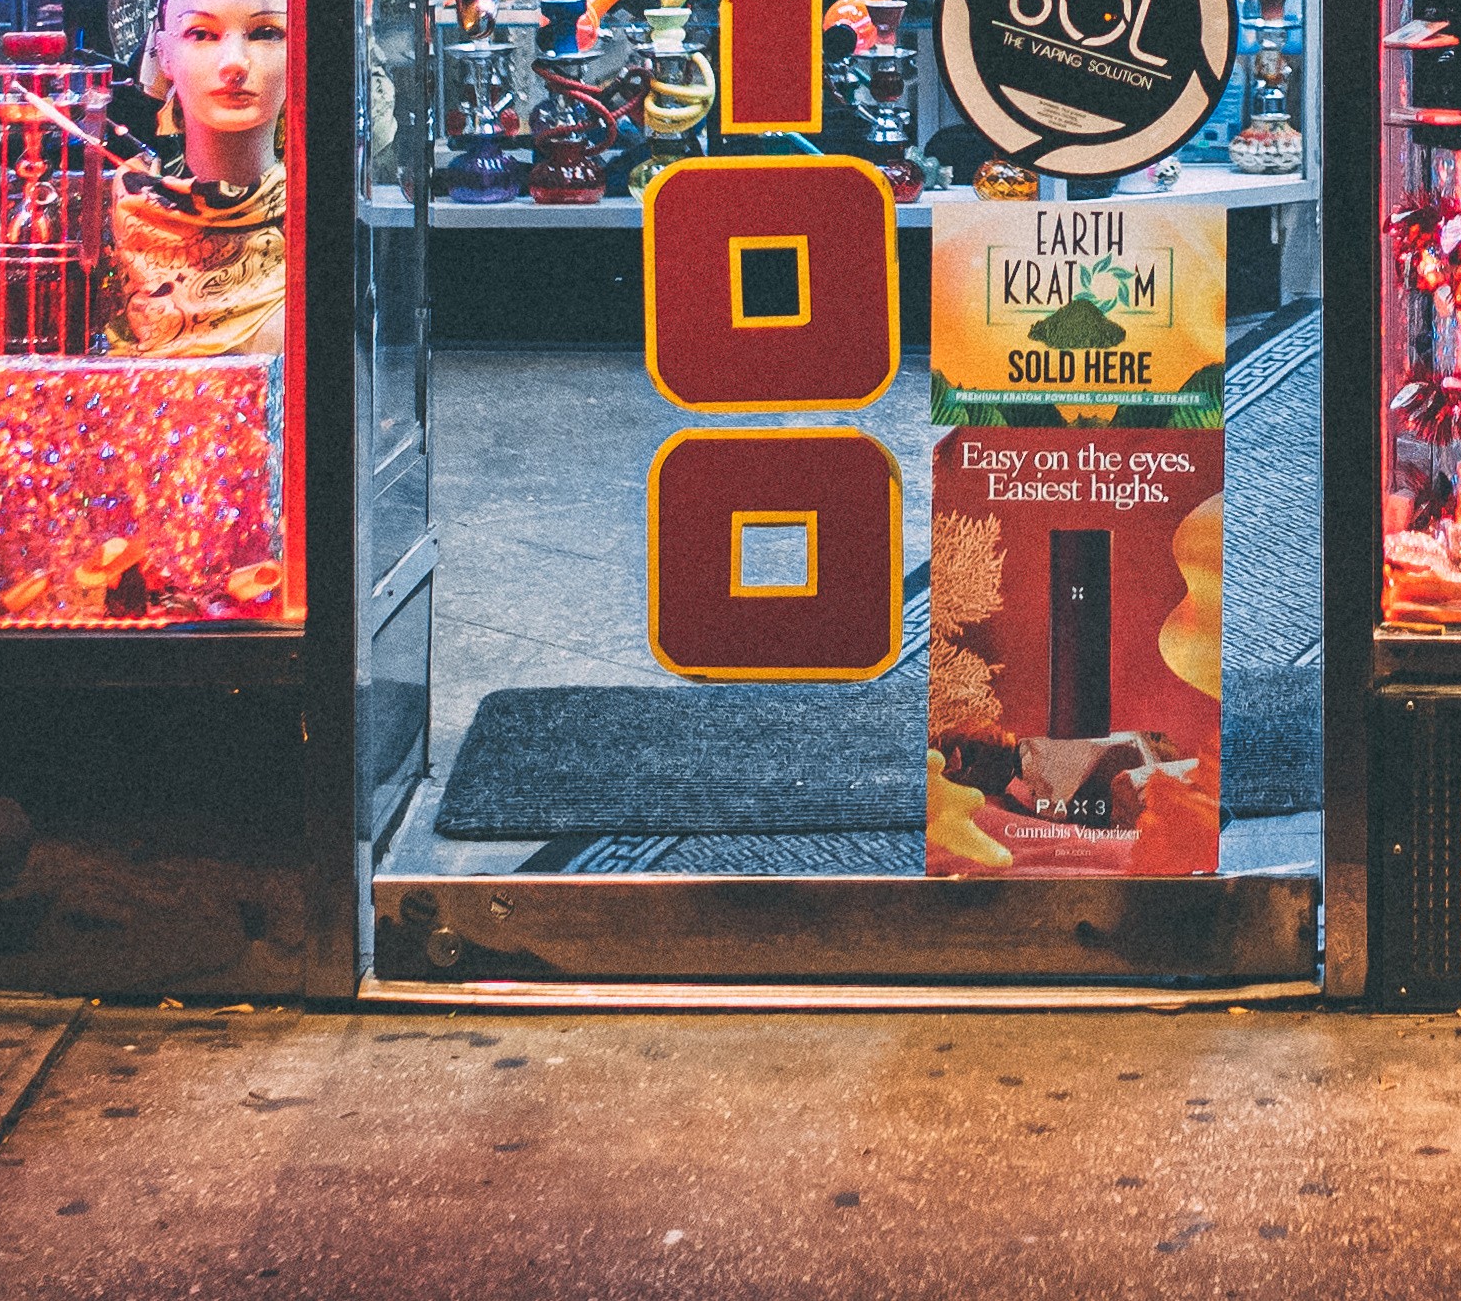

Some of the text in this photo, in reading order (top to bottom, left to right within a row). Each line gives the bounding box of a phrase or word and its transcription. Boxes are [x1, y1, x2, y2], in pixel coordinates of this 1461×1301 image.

[1002, 31, 1153, 91] THE VAPING SOLUTION
[1036, 211, 1125, 257] EARTH
[1007, 350, 1153, 385] SOLD HERE
[956, 392, 1000, 401] PREMIUM
[1003, 392, 1043, 402] KRATOM
[1095, 394, 1143, 403] CAPSULES
[1153, 395, 1200, 404] EXTRACTS
[961, 441, 1197, 480] Easy on the eyes.
[986, 472, 1170, 510] Easiest highs.
[1035, 798, 1107, 817] PAX 3
[1004, 822, 1143, 843] Cannabis Vaporizer
